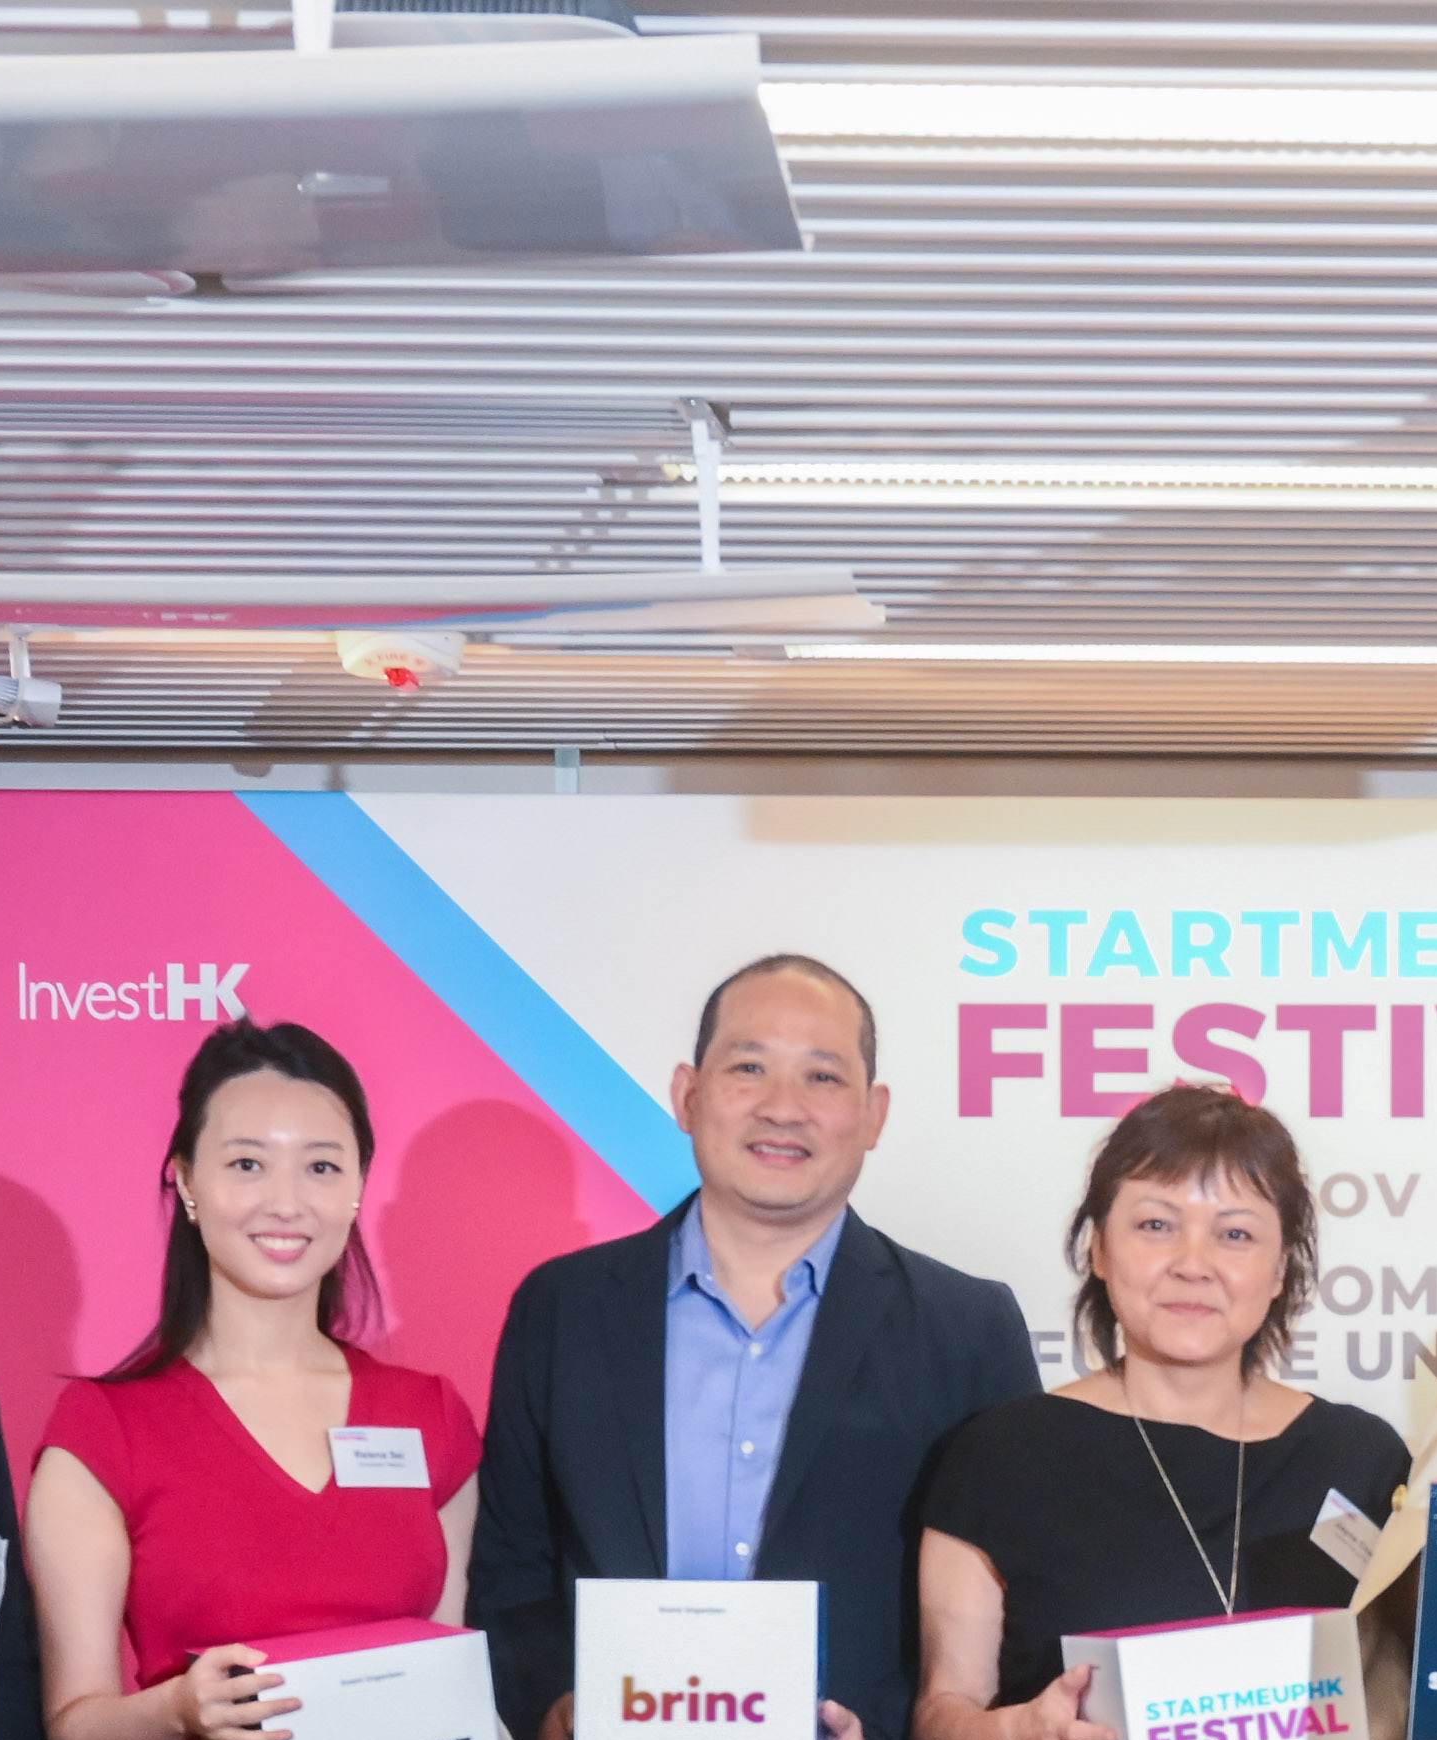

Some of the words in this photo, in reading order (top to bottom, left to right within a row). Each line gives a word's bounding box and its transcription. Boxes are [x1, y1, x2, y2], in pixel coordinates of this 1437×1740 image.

[19, 962, 250, 1021] InvestHK
[622, 1676, 765, 1723] brinc
[1146, 1678, 1344, 1721] STARTMEUPHK
